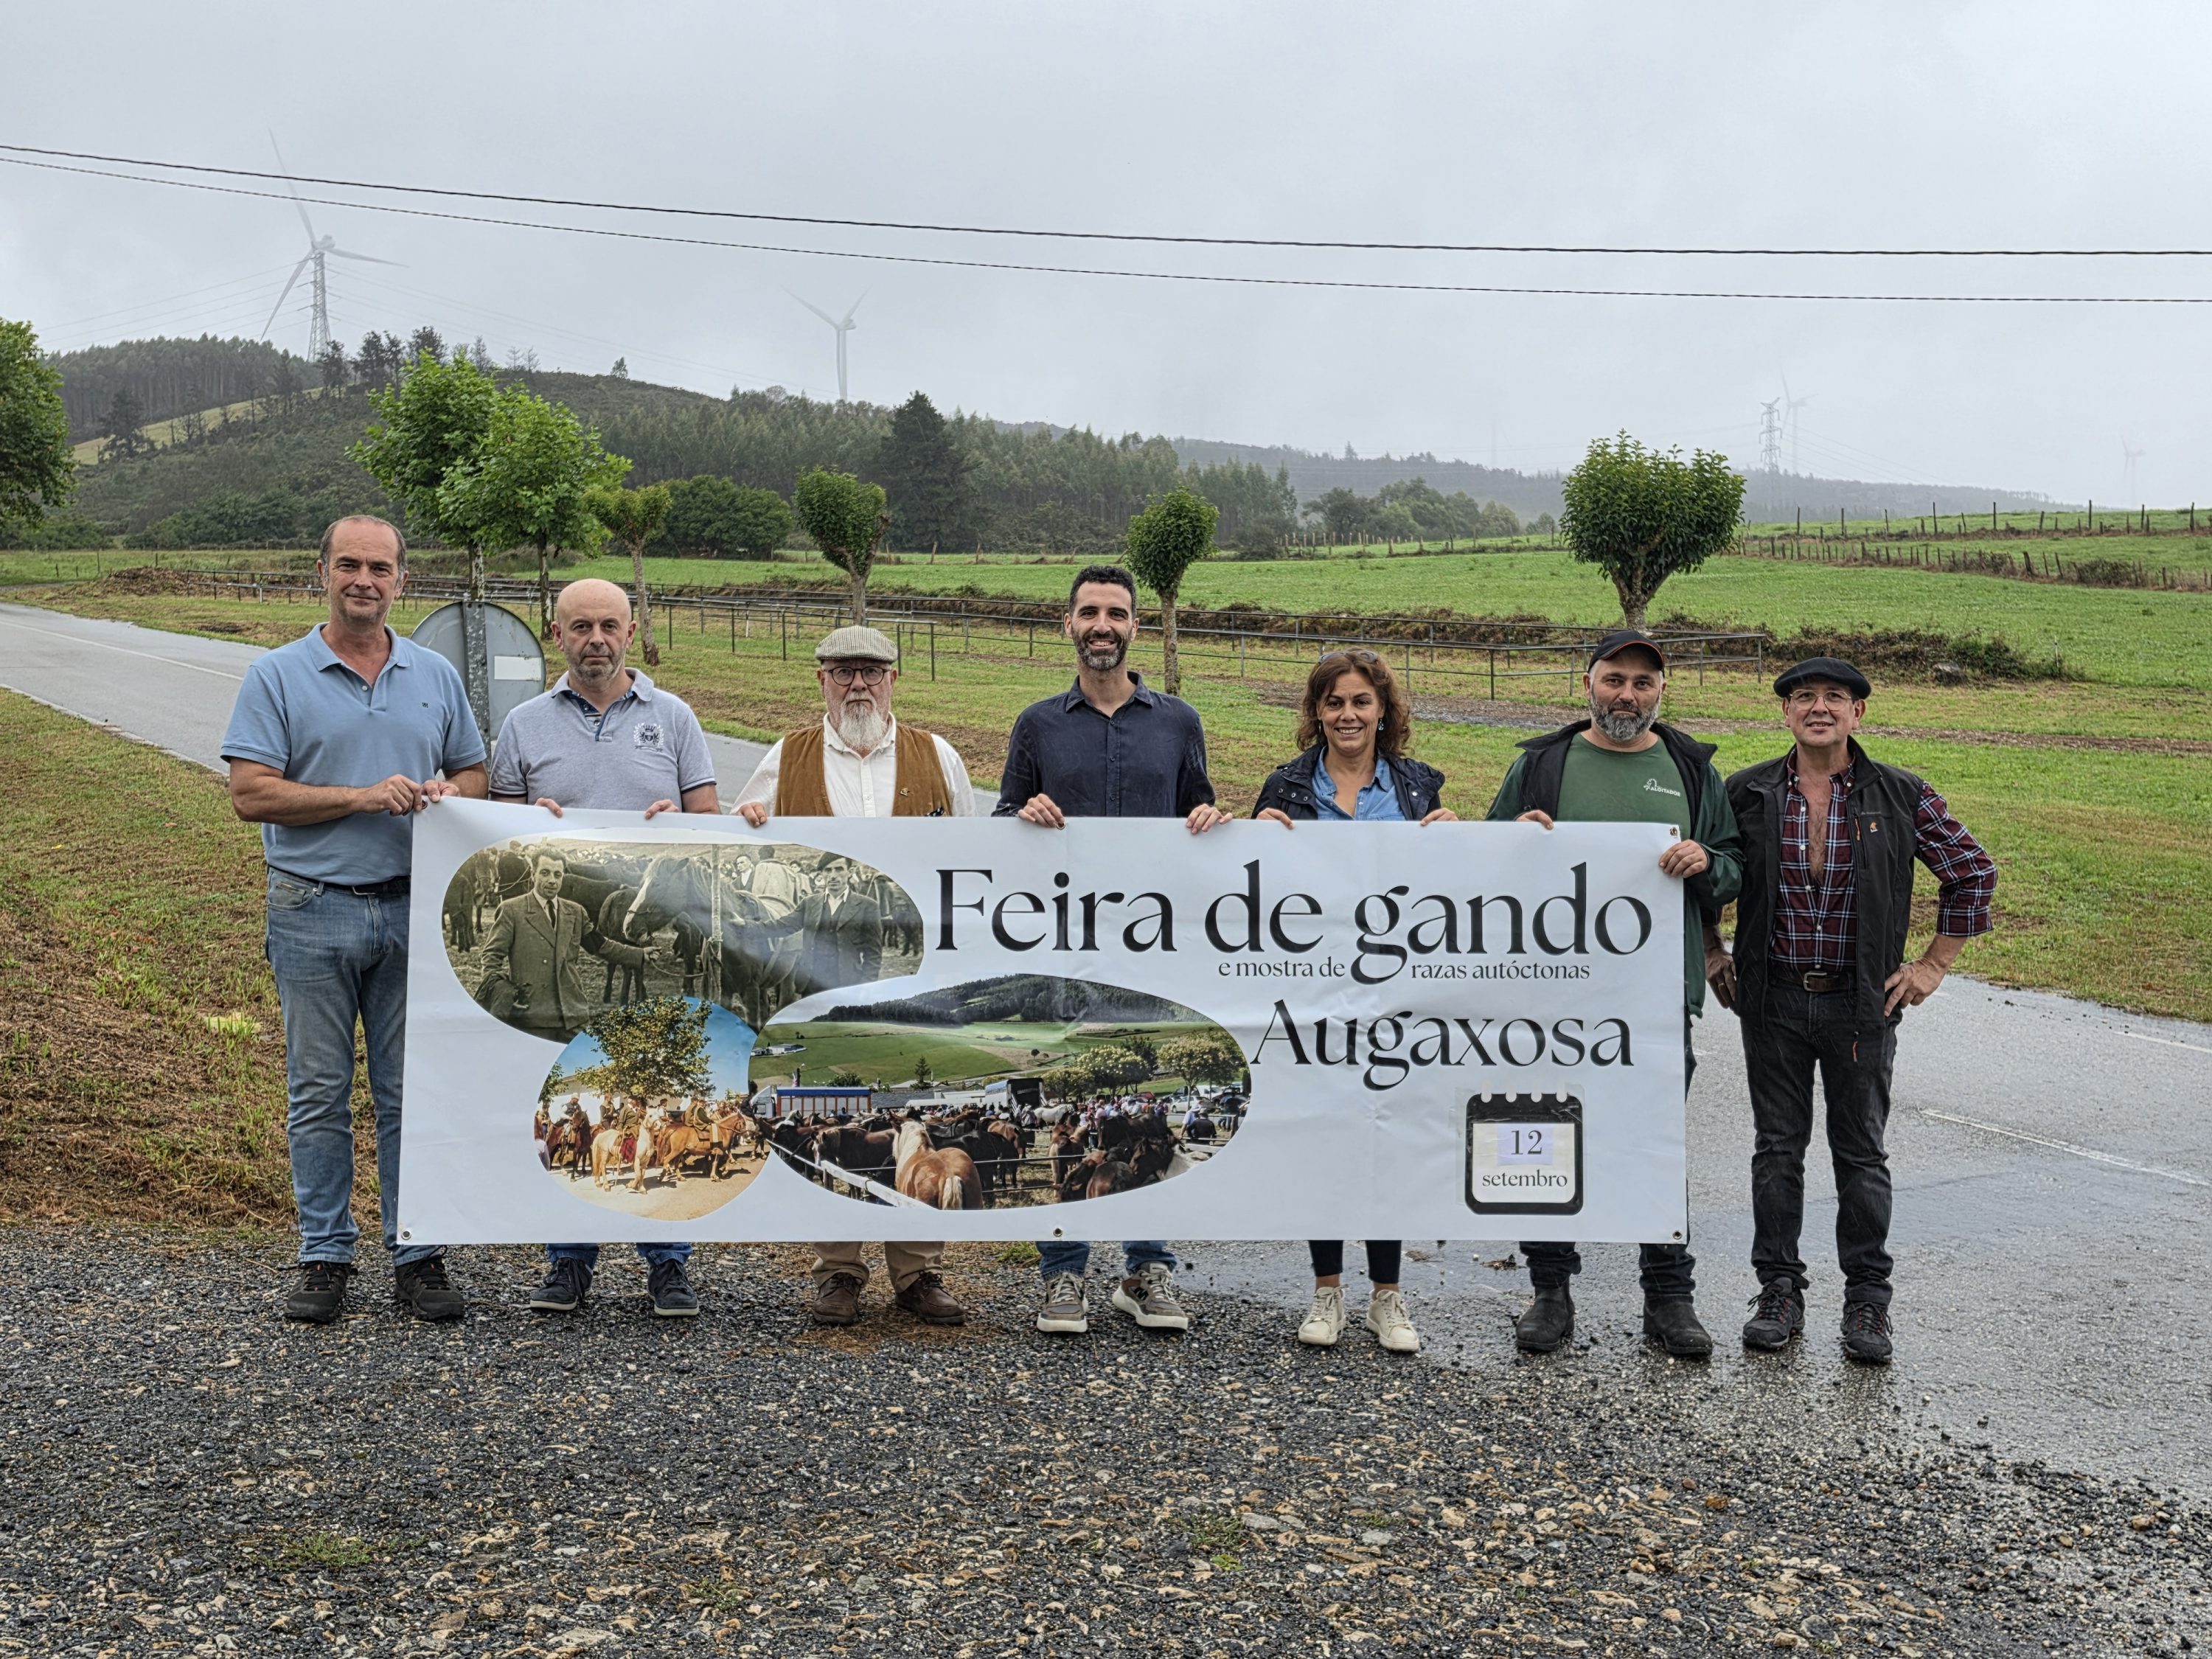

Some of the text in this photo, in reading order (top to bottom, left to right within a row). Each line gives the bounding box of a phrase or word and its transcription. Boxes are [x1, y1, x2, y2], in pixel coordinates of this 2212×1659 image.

[1651, 787, 1680, 797] ALOITADOR
[935, 859, 1652, 985] Feira de gando
[1218, 956, 1590, 980] e mostra de razas autóctonas
[1250, 999, 1635, 1091] Augaxosa
[1511, 1129, 1543, 1155] 12
[1482, 1169, 1568, 1187] setembro
